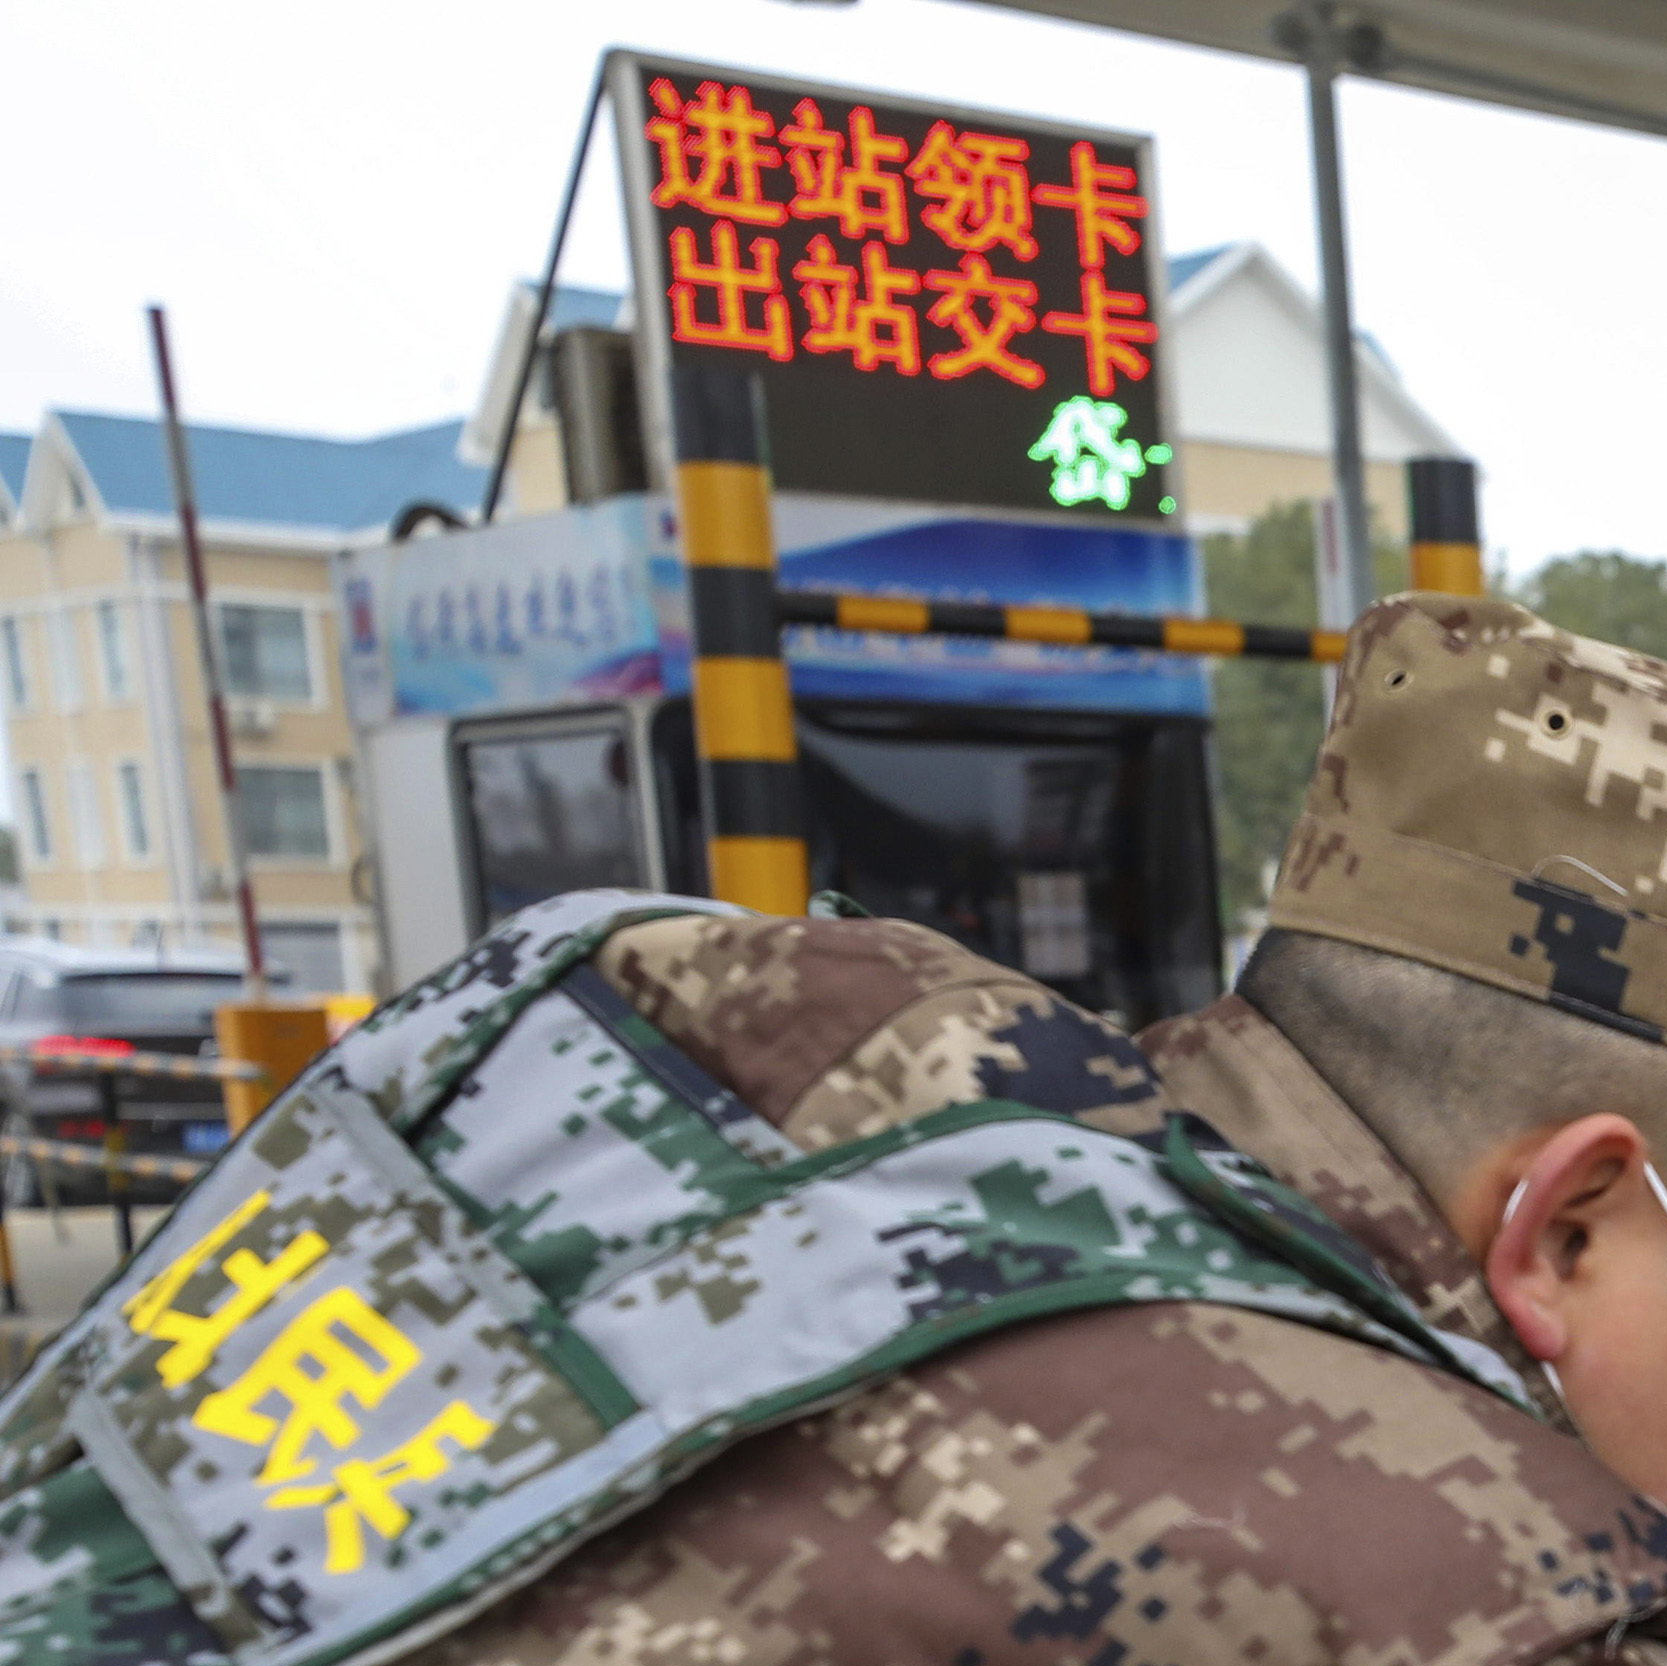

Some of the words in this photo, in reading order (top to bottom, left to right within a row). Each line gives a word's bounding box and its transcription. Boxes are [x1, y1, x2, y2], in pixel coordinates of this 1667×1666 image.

[644, 77, 1150, 270] 进站领卡
[668, 218, 1159, 397] 出站交卡
